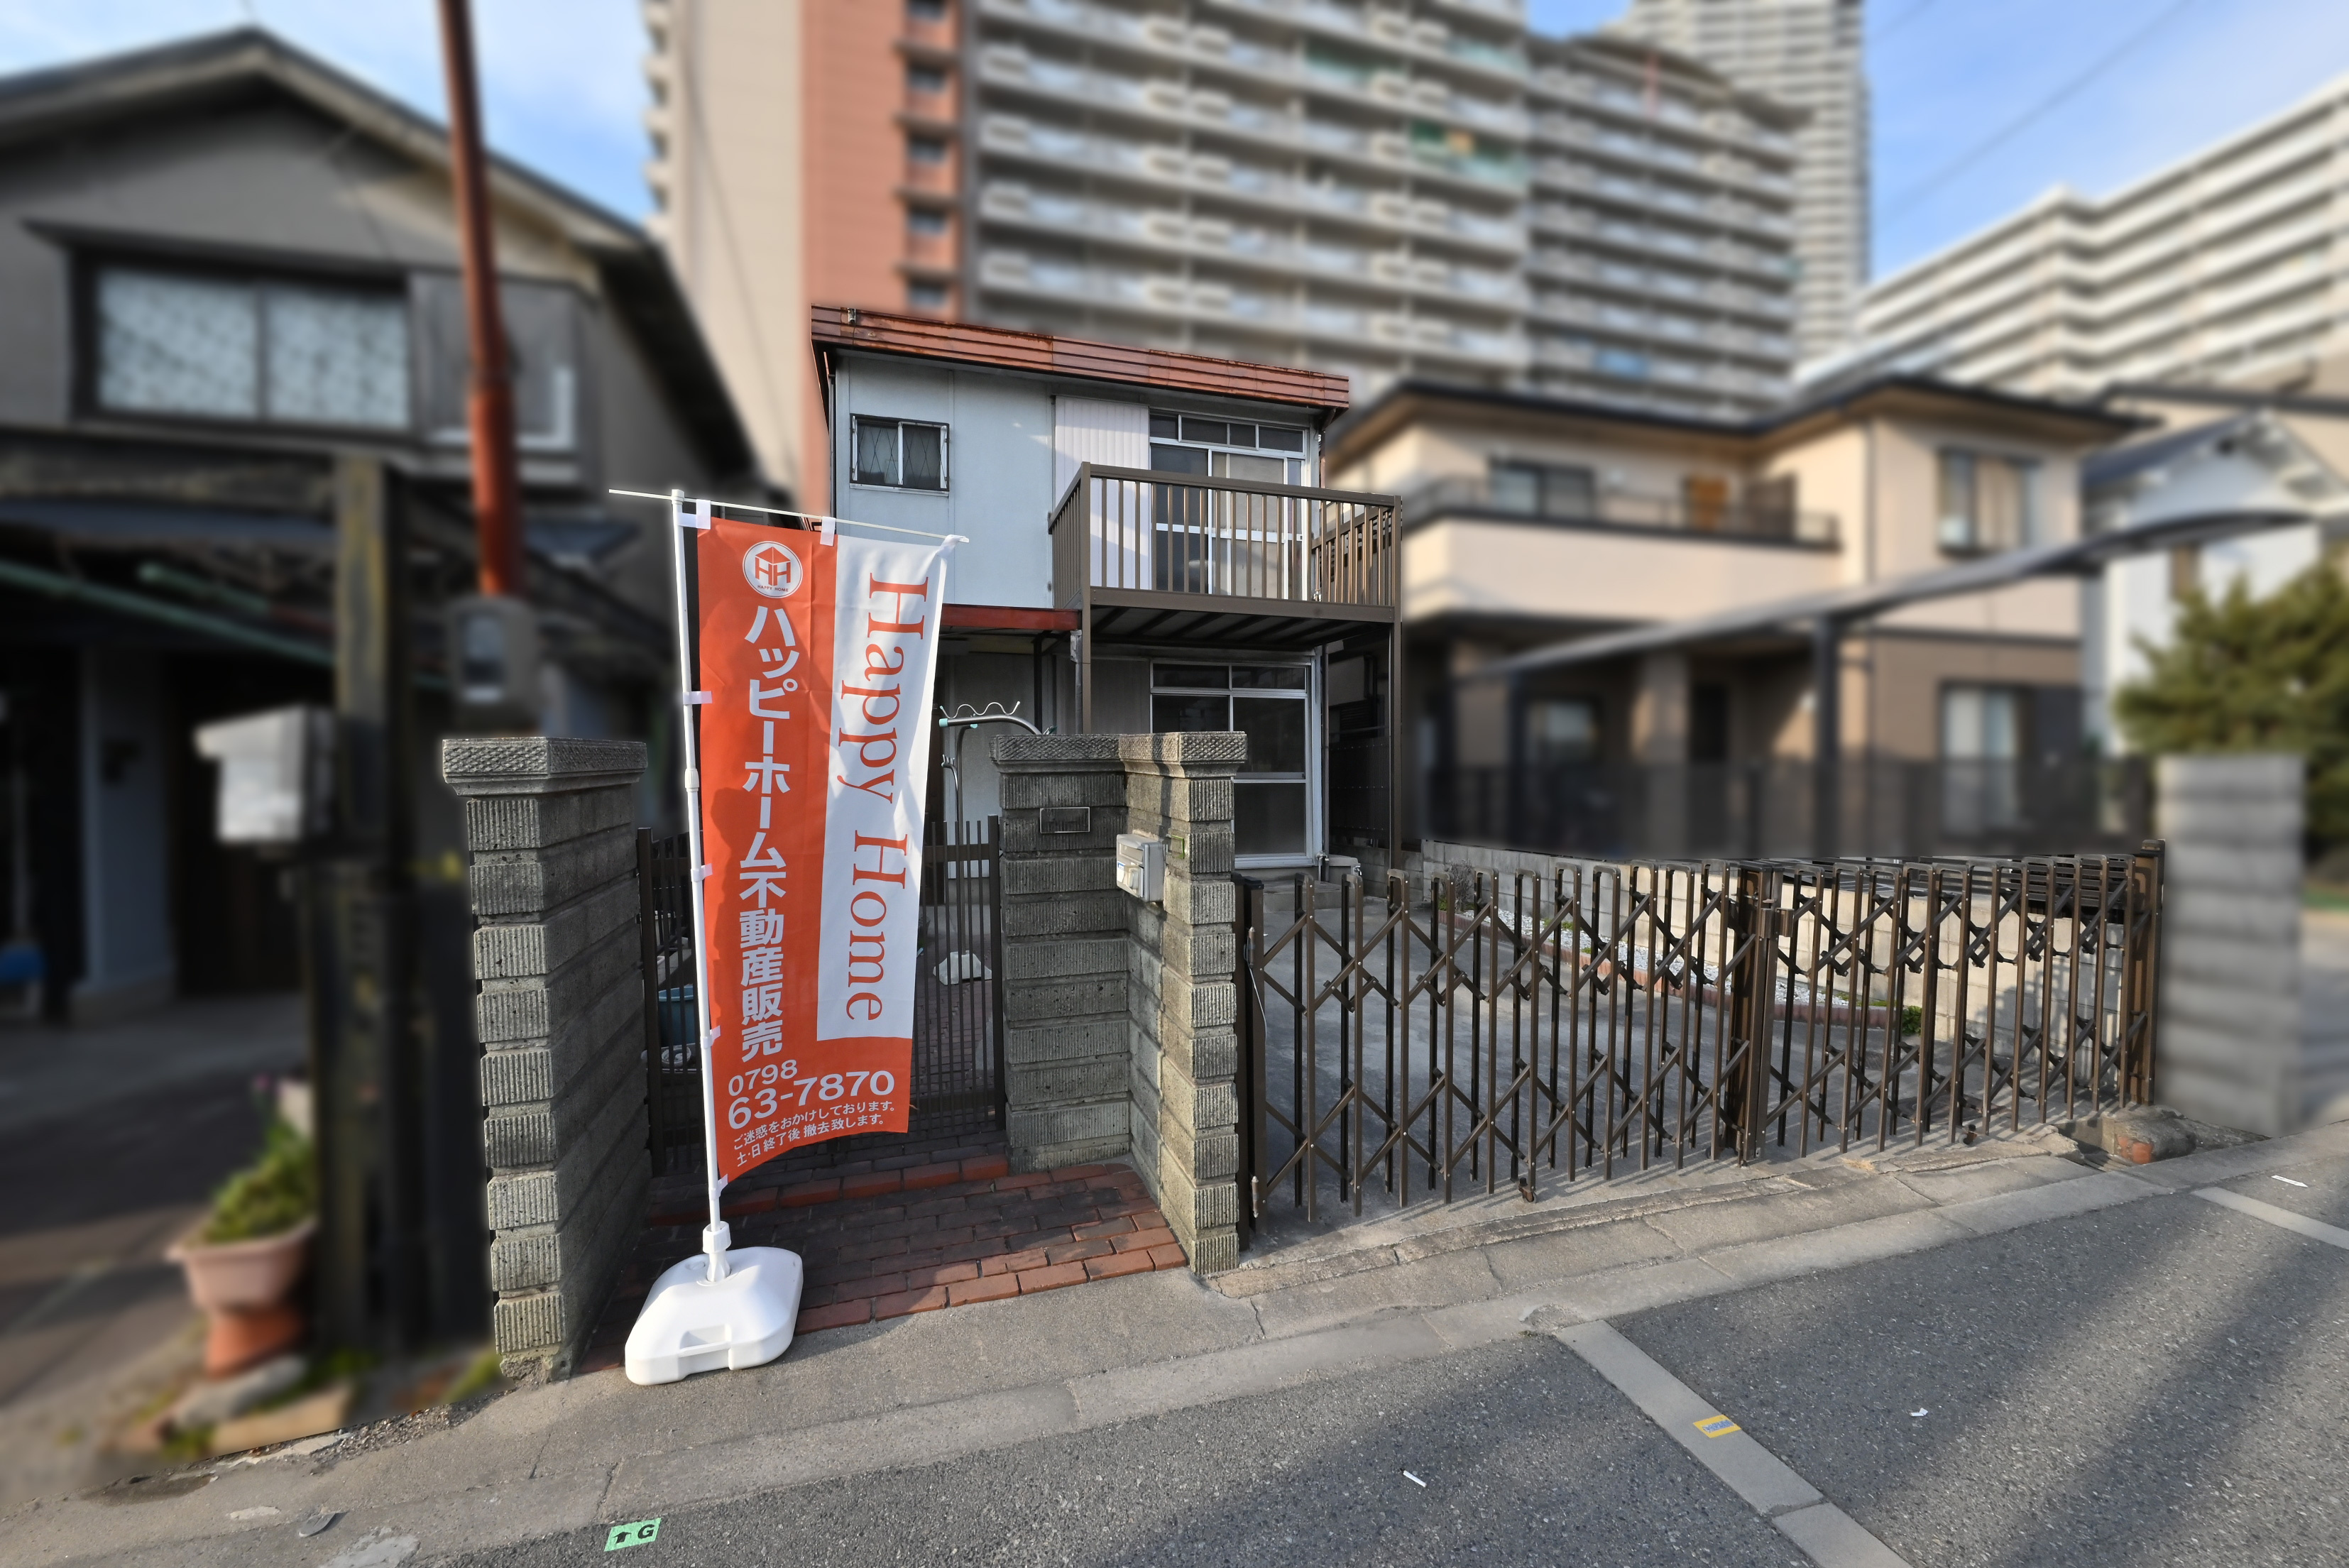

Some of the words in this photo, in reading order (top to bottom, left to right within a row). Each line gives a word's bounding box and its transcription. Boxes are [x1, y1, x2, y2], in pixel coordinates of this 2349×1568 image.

[837, 572, 928, 804] Happy
[739, 605, 800, 1062] ハッピーホーム不動産販売
[846, 830, 909, 1021] Home
[728, 1059, 798, 1096] 0798
[728, 1070, 894, 1129] 63-7870
[734, 1100, 894, 1150] ご迷惑をおかけしております。
[637, 1524, 655, 1539] G
